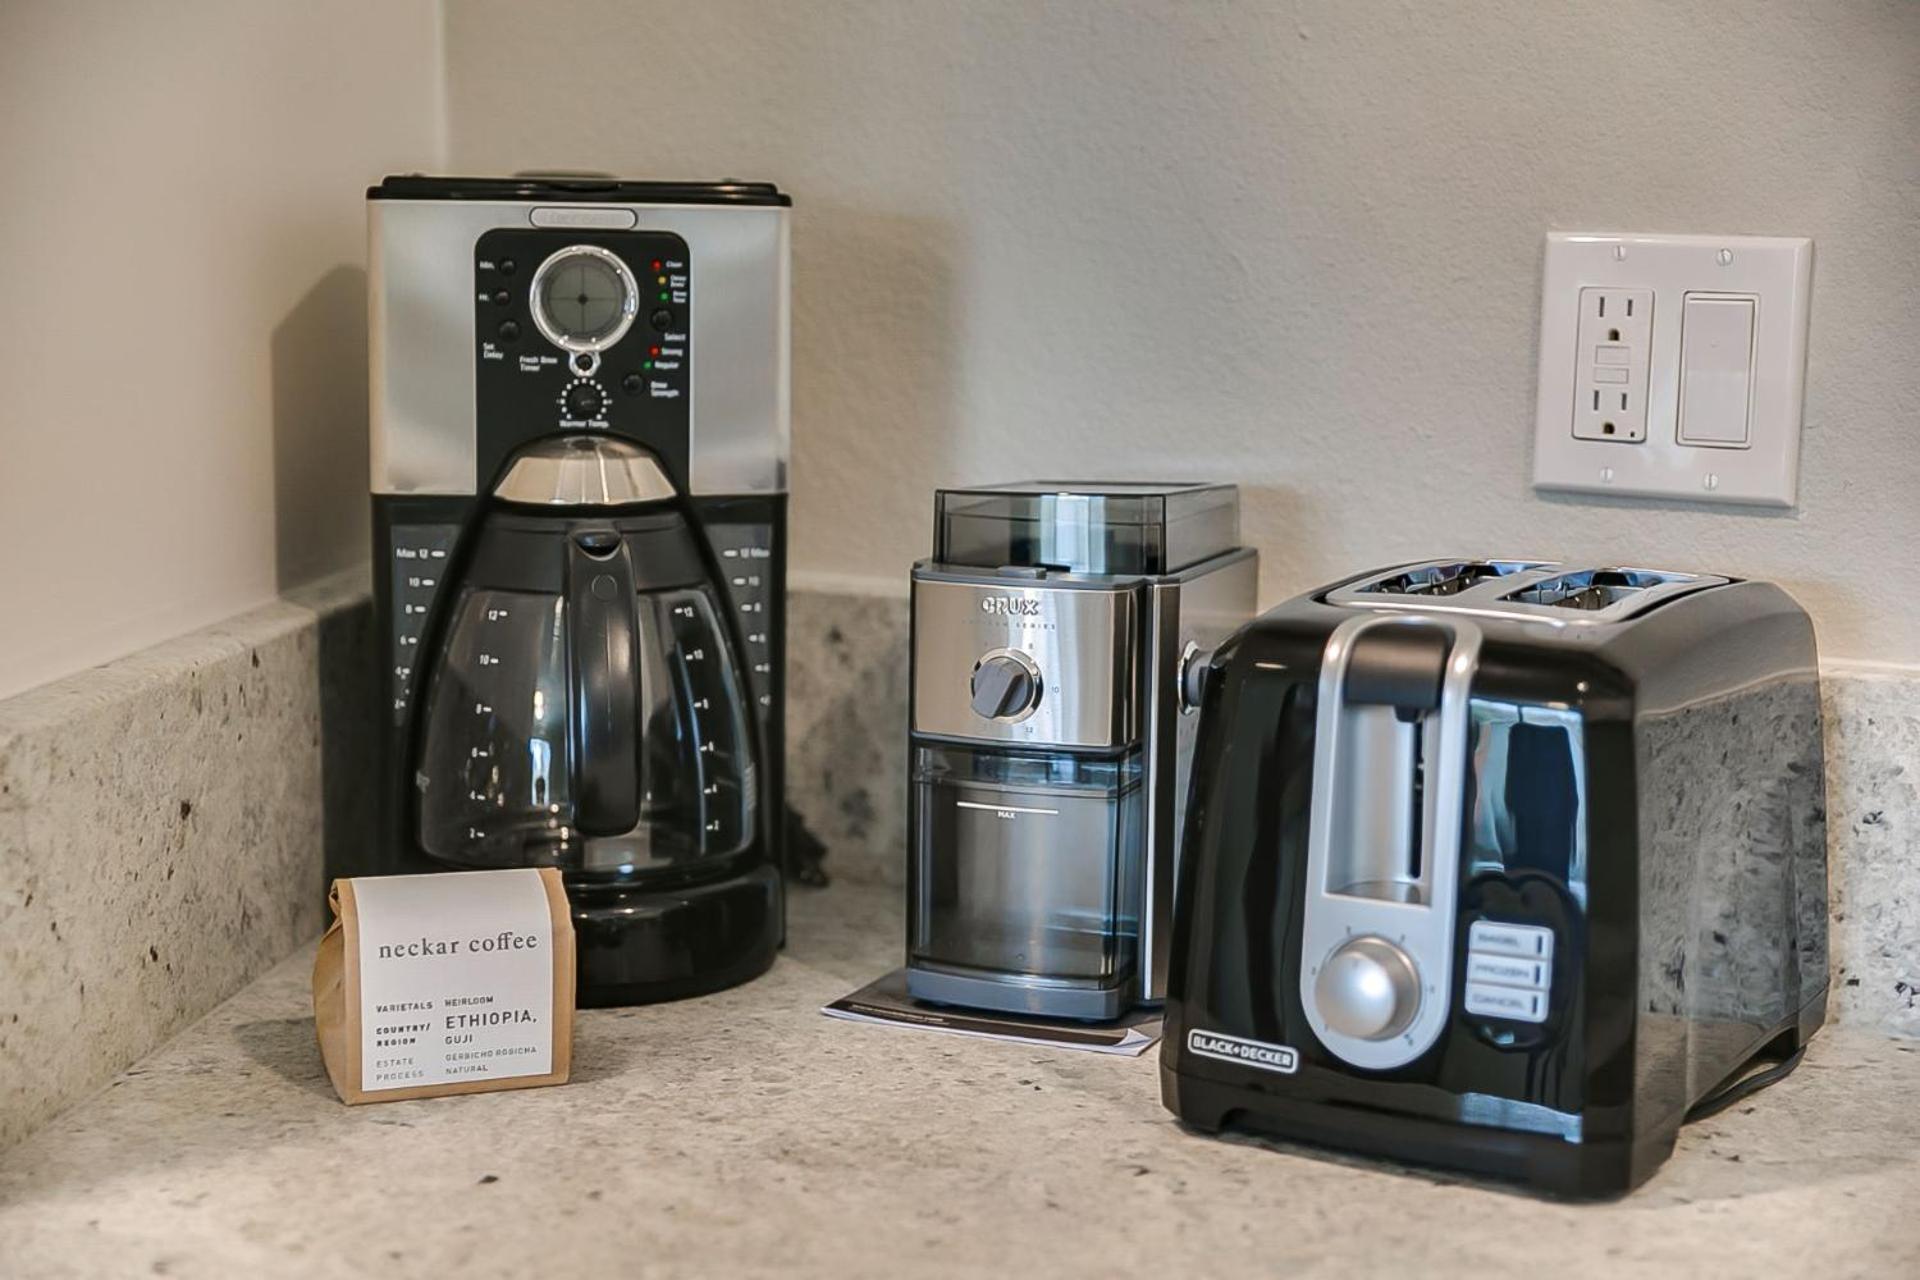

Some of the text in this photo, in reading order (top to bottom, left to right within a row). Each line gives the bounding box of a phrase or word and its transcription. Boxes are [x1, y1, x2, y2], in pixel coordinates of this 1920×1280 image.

[408, 577, 420, 588] 10
[488, 609, 499, 621] 12
[479, 653, 490, 666] 10
[997, 810, 1017, 820] MAX
[379, 931, 538, 959] neckar coffee
[375, 996, 494, 1013] VARIETALS HEIRLOOM
[375, 1022, 431, 1035] COUNTRY/
[376, 1034, 473, 1047] REGION GUJI
[376, 1057, 414, 1068] ESTATE
[376, 1064, 489, 1081] PROCESS NATURAL
